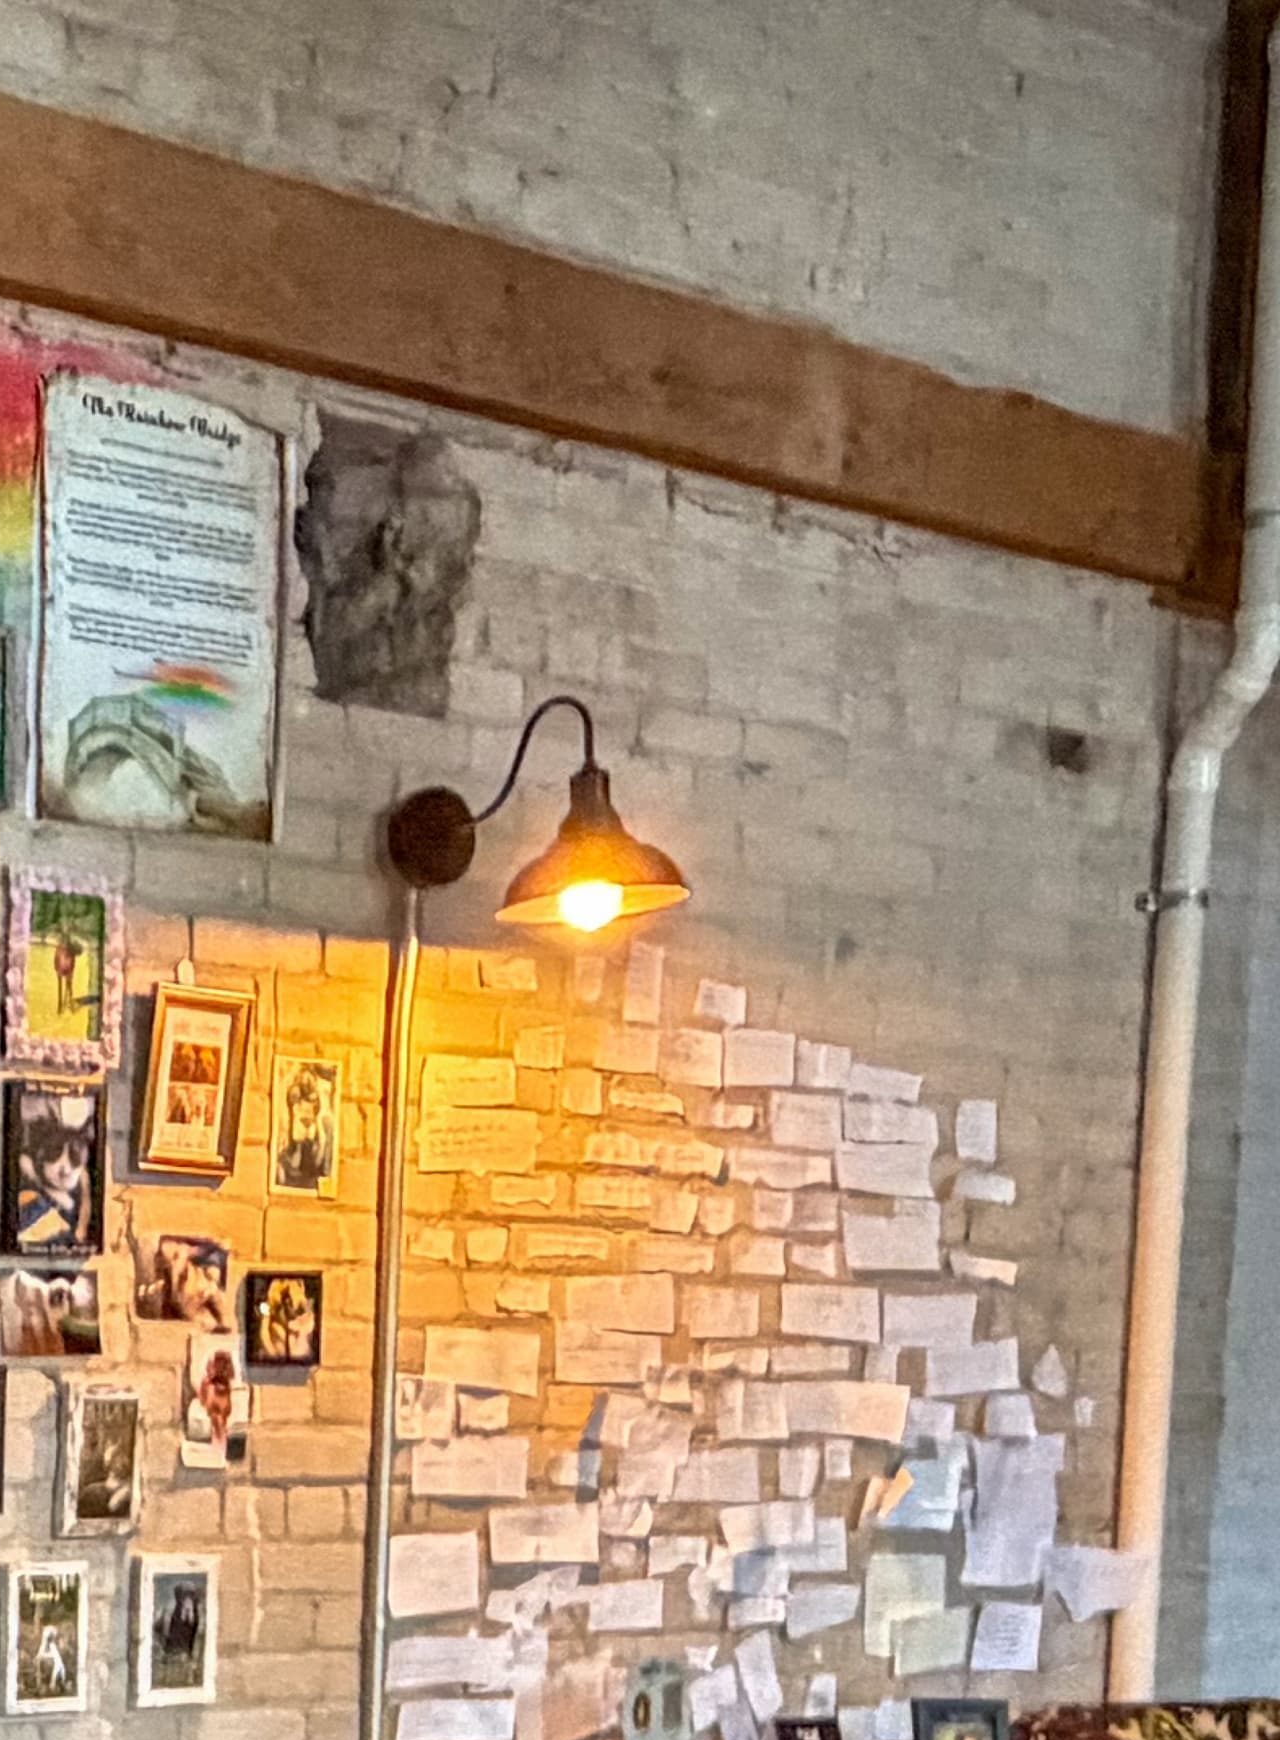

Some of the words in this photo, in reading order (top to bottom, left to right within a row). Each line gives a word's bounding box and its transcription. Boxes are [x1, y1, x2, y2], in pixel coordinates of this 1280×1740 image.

[82, 393, 114, 417] The
[117, 401, 186, 431] Rainbow
[190, 415, 241, 449] Bridge
